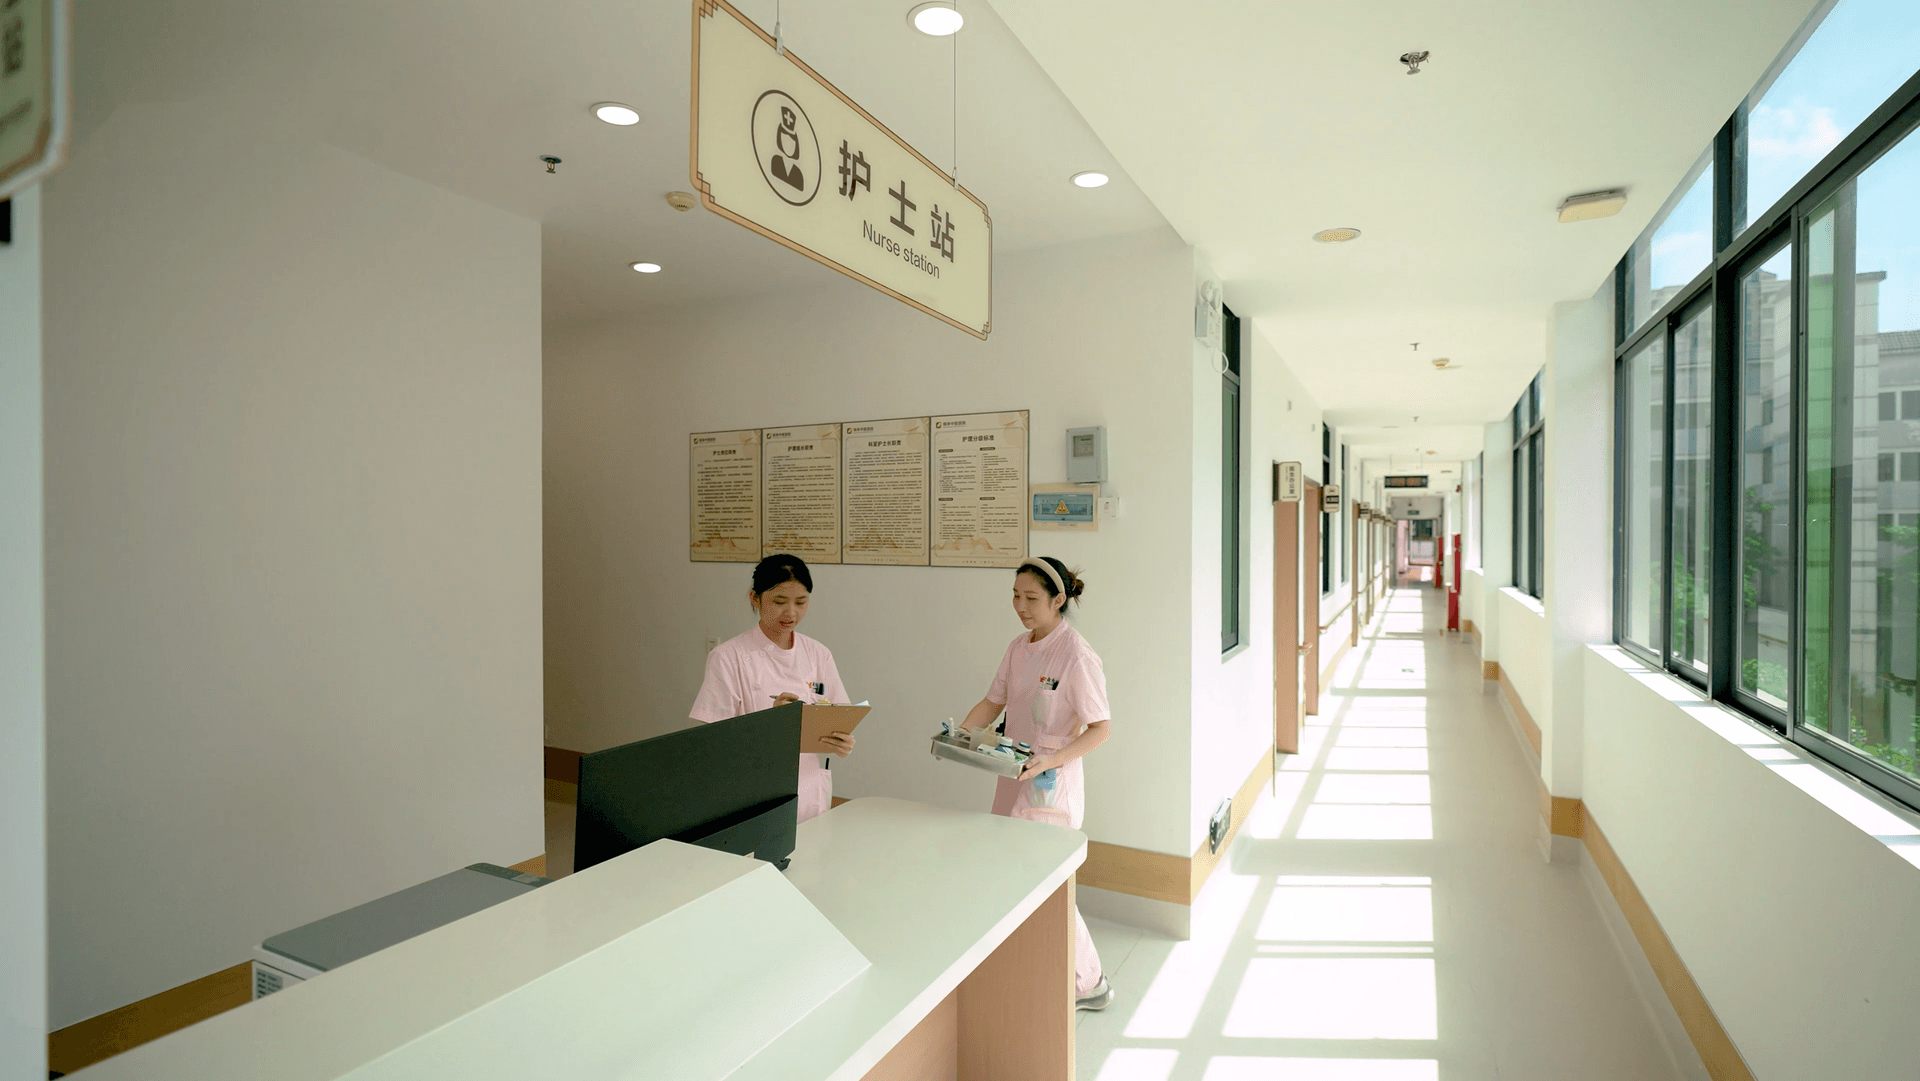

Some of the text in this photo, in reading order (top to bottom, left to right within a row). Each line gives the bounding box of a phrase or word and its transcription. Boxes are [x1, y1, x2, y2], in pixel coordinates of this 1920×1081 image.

[838, 139, 955, 263] 护士站
[863, 219, 940, 279] Nurse station
[962, 434, 995, 443] 护理分级标准
